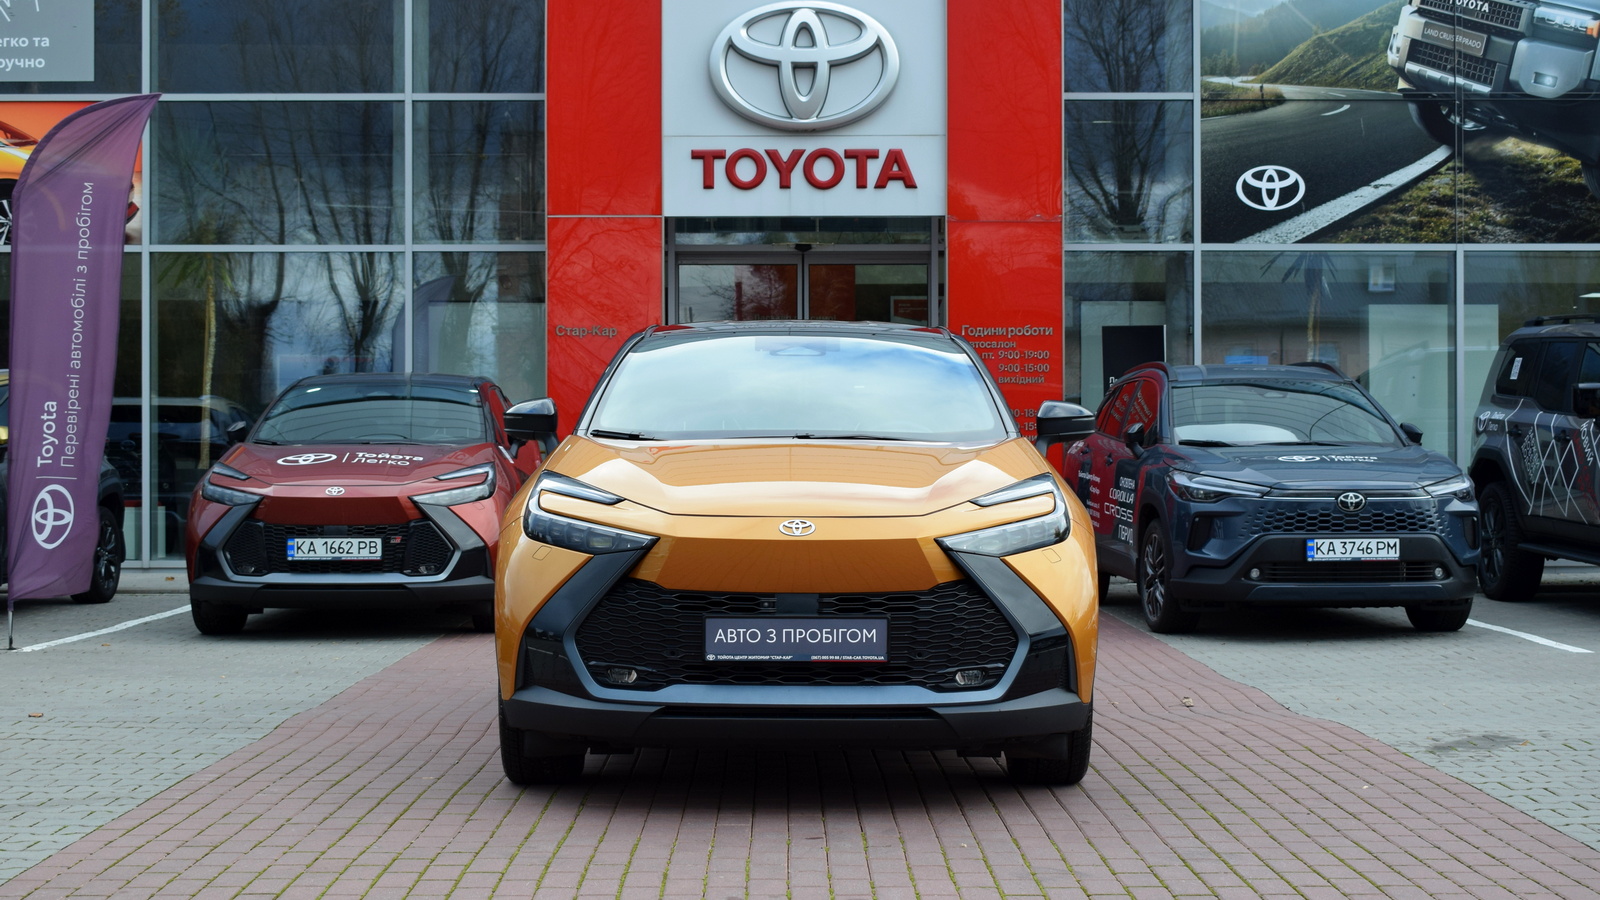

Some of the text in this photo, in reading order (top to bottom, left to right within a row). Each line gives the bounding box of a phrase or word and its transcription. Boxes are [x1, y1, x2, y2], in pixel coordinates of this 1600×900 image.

[1450, 0, 1489, 12] OYOTA
[1424, 28, 1438, 37] LAND
[33, 37, 50, 47] та
[691, 148, 918, 190] TOYOTA
[60, 182, 95, 467] Перевірені автомобілі з пробігом
[555, 324, 618, 339] Стар-Кар
[961, 325, 1053, 338] Години роботи
[970, 341, 1016, 349] втосалон
[998, 375, 1045, 384] вихідний
[37, 401, 59, 468] Toyota
[351, 458, 410, 466] Легко
[355, 452, 424, 461] Тойота
[1109, 488, 1134, 504] COROLLA
[1104, 502, 1133, 522] CROSS
[296, 540, 378, 554] KA 1662 PB
[1315, 541, 1398, 555] KA 3746 PM
[714, 628, 877, 643] АВТО З ПРОБІГОМ
